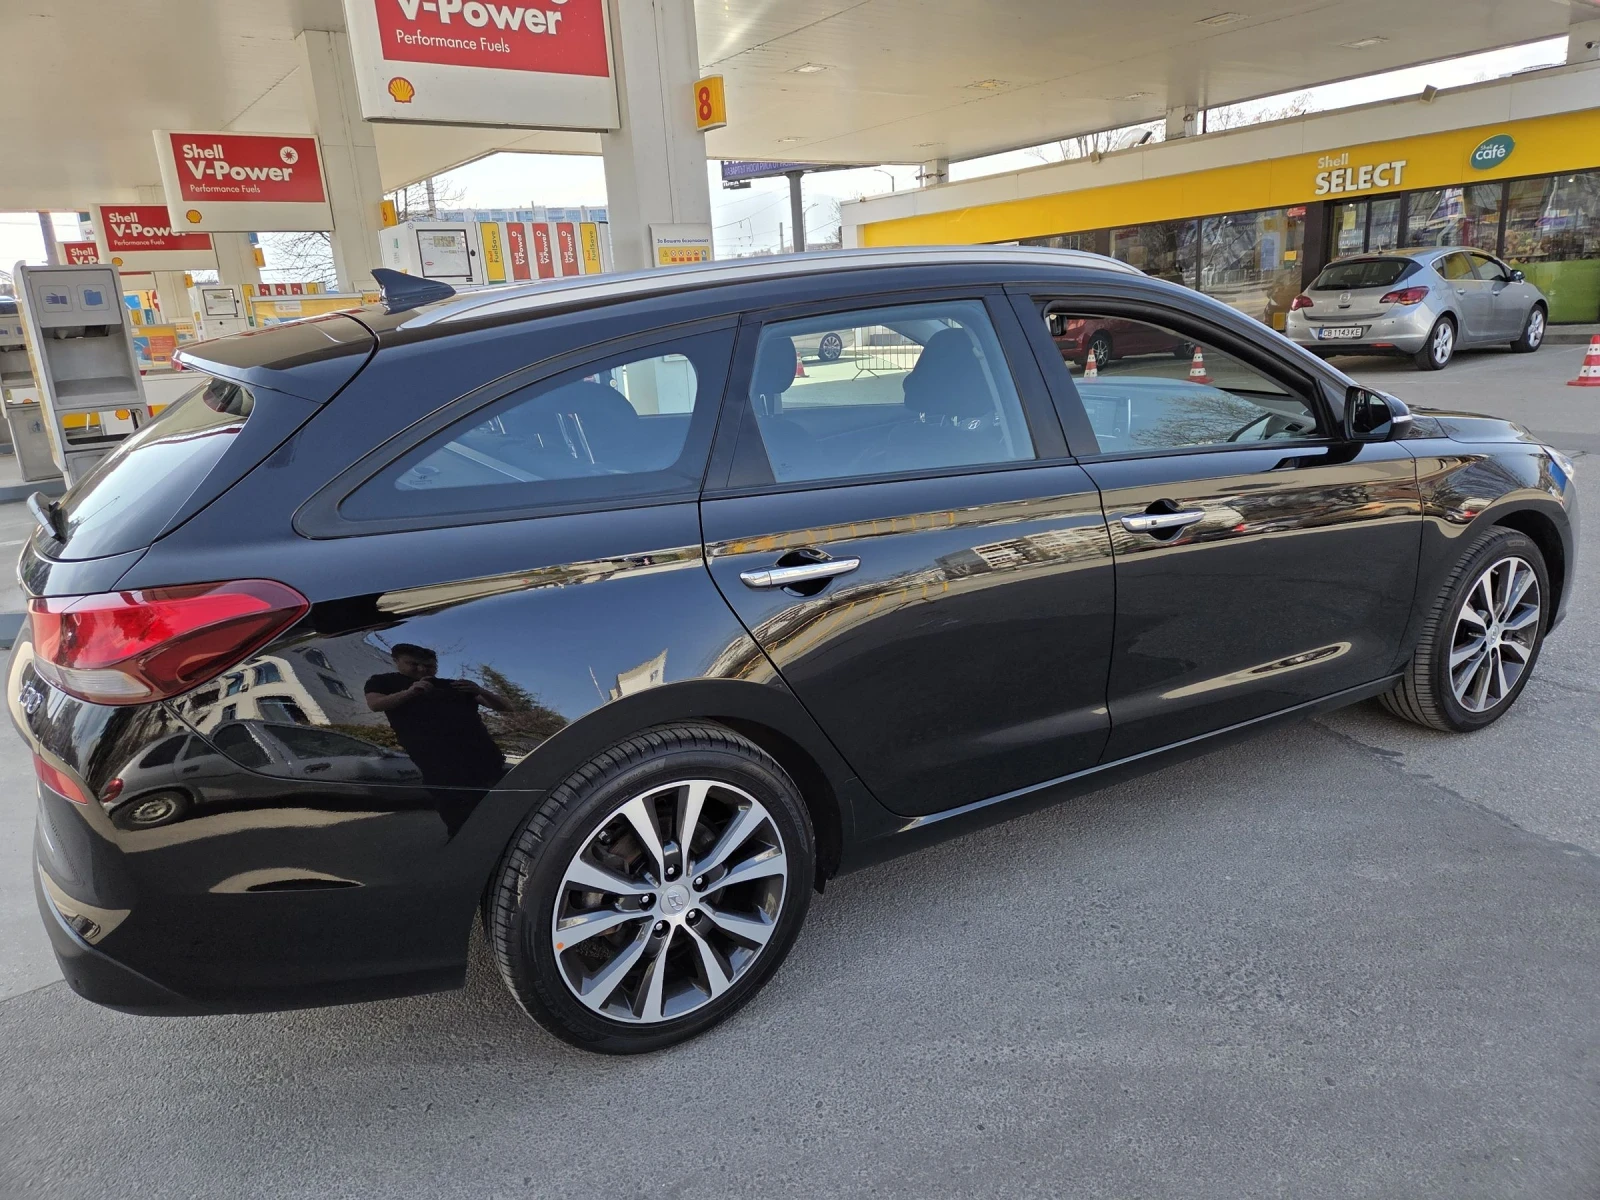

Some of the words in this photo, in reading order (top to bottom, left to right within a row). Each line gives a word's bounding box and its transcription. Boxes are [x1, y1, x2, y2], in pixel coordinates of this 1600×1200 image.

[397, 0, 562, 35] V-Power
[396, 29, 477, 51] Performance
[481, 36, 511, 54] Fuels
[698, 86, 712, 121] 8
[182, 143, 224, 159] Shell
[1317, 153, 1349, 169] Shell
[1475, 144, 1506, 161] café
[185, 160, 293, 181] V-Power
[1315, 160, 1407, 195] SELECT
[190, 184, 240, 193] Performance
[241, 184, 261, 194] Fuels
[108, 212, 139, 223] Shell
[70, 247, 94, 256] Shell
[491, 230, 499, 263] FuelSave
[517, 233, 525, 265] V-Power
[542, 233, 550, 264] V-Power
